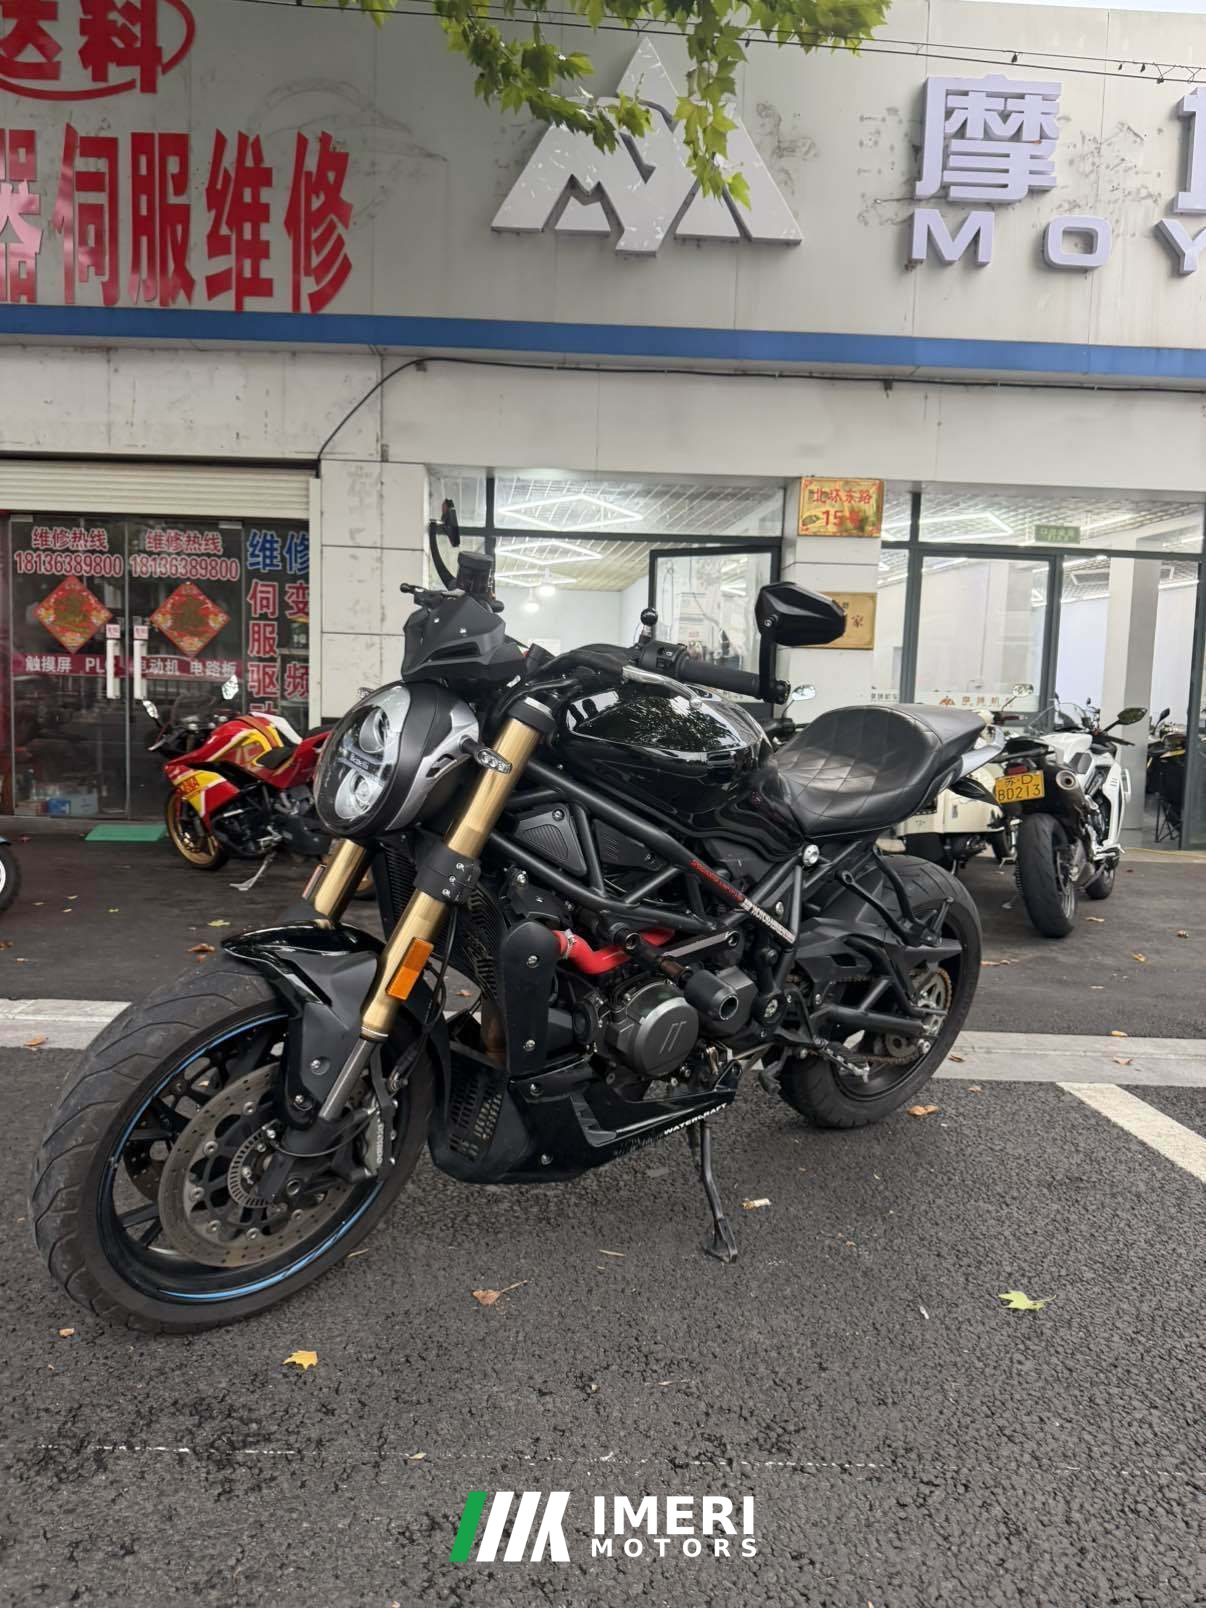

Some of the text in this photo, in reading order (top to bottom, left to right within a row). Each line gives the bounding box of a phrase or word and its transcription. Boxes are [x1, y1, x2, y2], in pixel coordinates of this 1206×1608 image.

[915, 73, 1206, 214] 摩
[32, 526, 108, 551] 维修热线
[145, 529, 223, 555] 维修热线
[14, 551, 124, 577] 18136389800
[129, 554, 240, 581] 18136389800
[189, 661, 238, 677] 电路板
